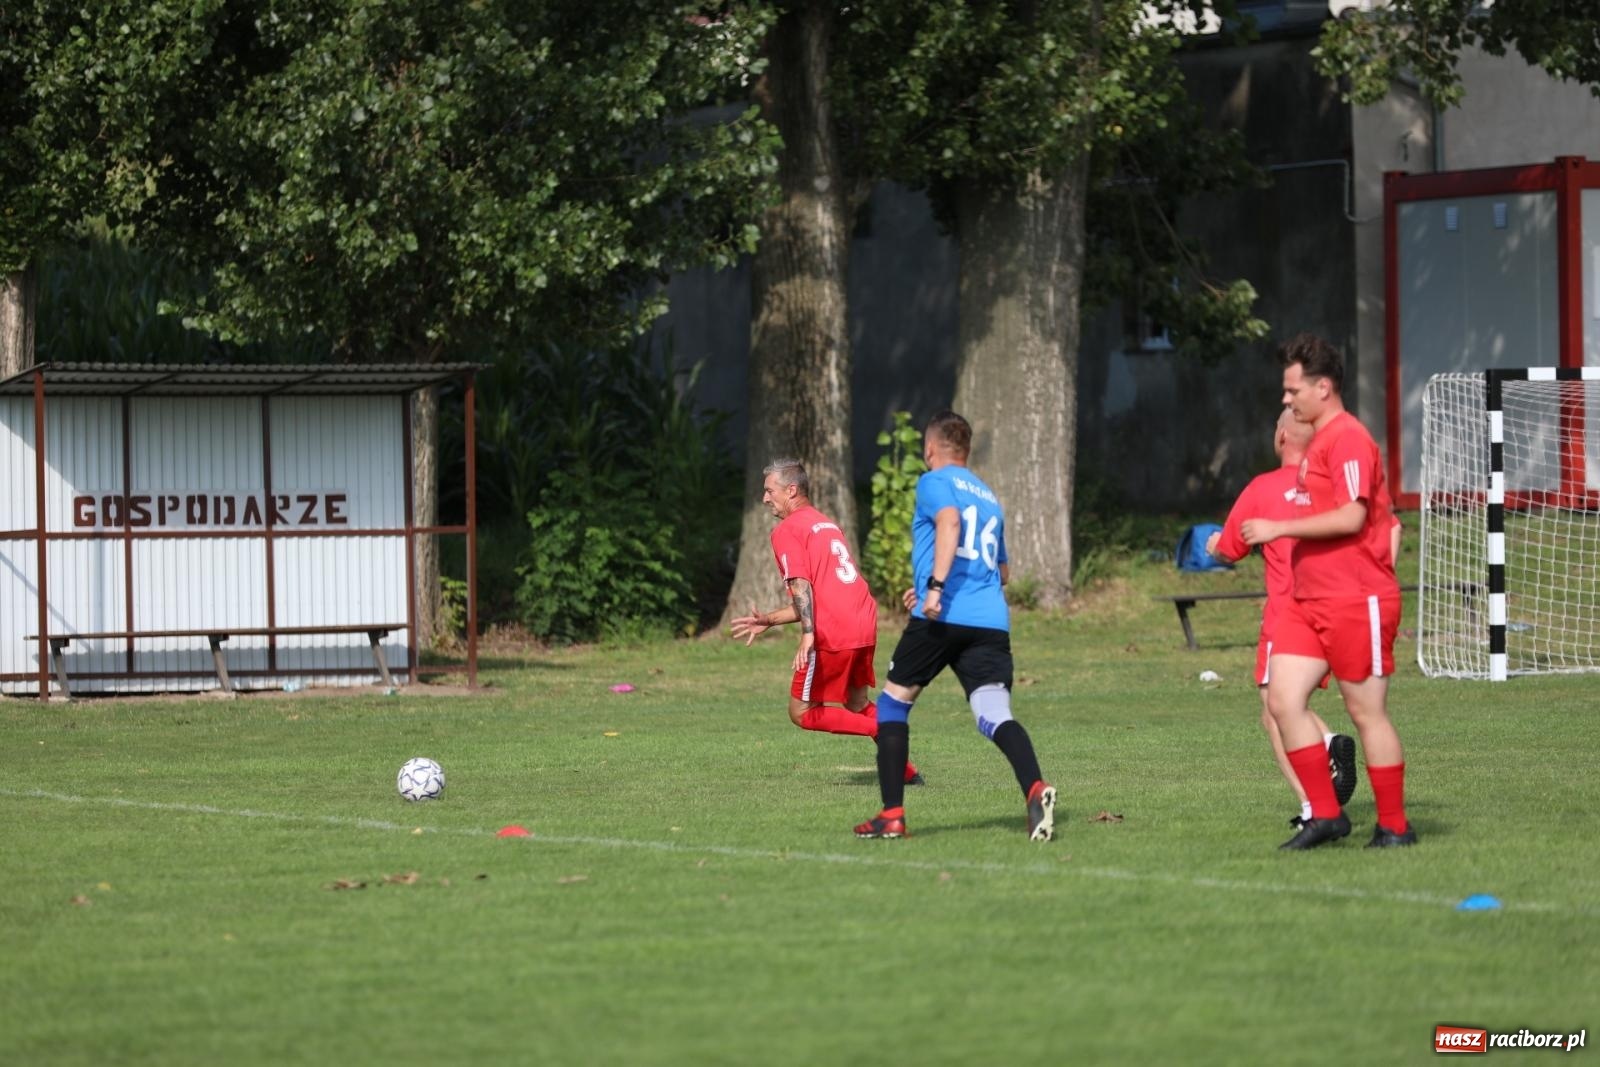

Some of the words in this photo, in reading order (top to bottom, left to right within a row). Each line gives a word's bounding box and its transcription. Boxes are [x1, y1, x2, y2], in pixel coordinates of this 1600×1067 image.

[74, 494, 347, 526] GOSPODARZE
[955, 505, 998, 570] 16
[831, 539, 857, 584] 3
